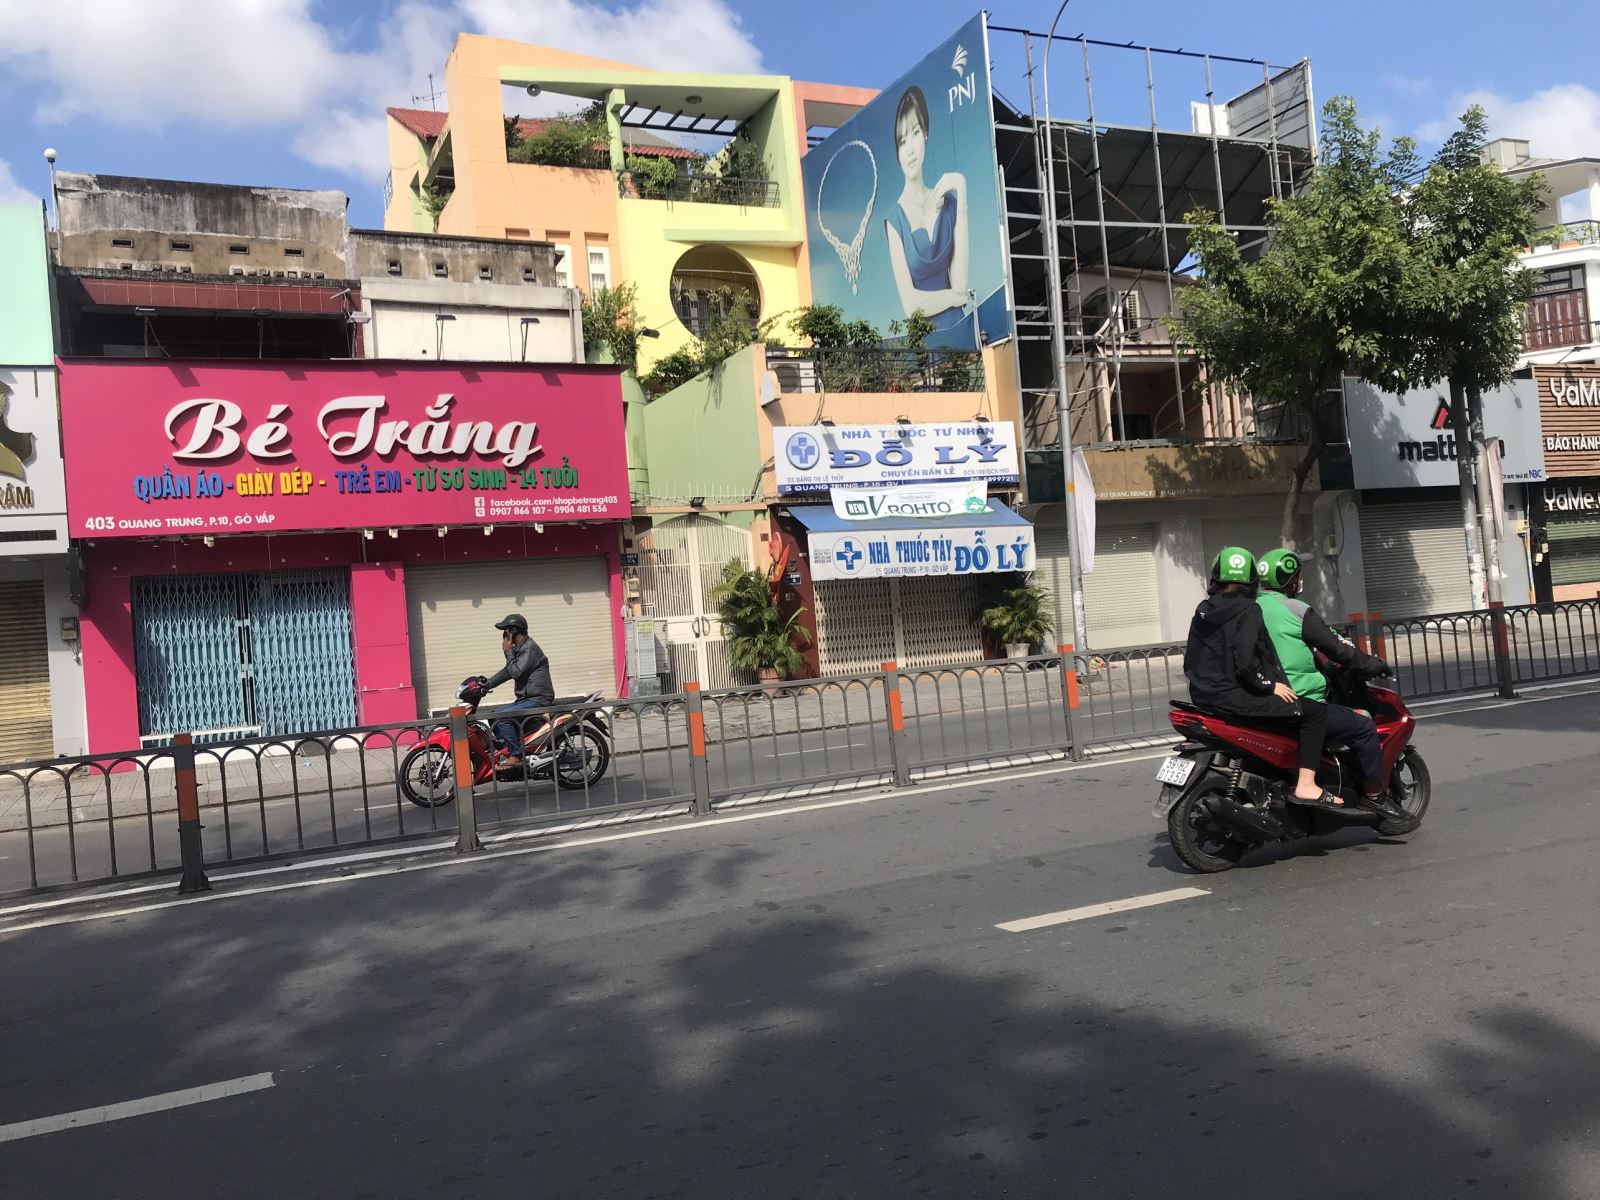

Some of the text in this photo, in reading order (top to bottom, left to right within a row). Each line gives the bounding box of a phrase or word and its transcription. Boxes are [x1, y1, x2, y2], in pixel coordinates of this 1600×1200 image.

[948, 71, 976, 113] PNJ
[1549, 377, 1600, 406] YaM
[164, 393, 543, 468] Bé Trắng
[841, 428, 872, 440] NHÀ
[879, 426, 927, 439] THUỐC
[933, 427, 953, 437] TƯ
[828, 437, 1007, 469] ĐỖ LÝ
[133, 465, 191, 504] QUẦN
[195, 469, 223, 498] ÁO
[235, 468, 274, 497] GIÀY
[280, 467, 313, 496] DÉP
[335, 464, 371, 494] TRẺ
[375, 471, 401, 494] EM
[412, 464, 437, 491] TỪ
[440, 466, 464, 491] SƠ
[468, 469, 507, 491] SINH
[518, 468, 537, 489] 14
[540, 456, 579, 489] TUỔI
[881, 467, 920, 478] CHUYÊN
[922, 467, 942, 476] BÁN
[794, 484, 829, 492] QUANG
[85, 516, 115, 531] 403
[118, 518, 162, 530] QUANG
[234, 513, 252, 525] GÒ
[255, 510, 275, 525] VẤP
[490, 507, 511, 516] 0907
[514, 506, 530, 515] 866
[533, 506, 546, 515] 107
[554, 505, 575, 514] 0904
[577, 504, 591, 514] 481
[849, 502, 865, 514] NEW
[869, 531, 952, 564] NHÀ THUỐC TÂY
[955, 529, 1028, 572] ĐỖ LÝ
[884, 566, 901, 575] QUANG
[901, 565, 917, 574] TRUNG
